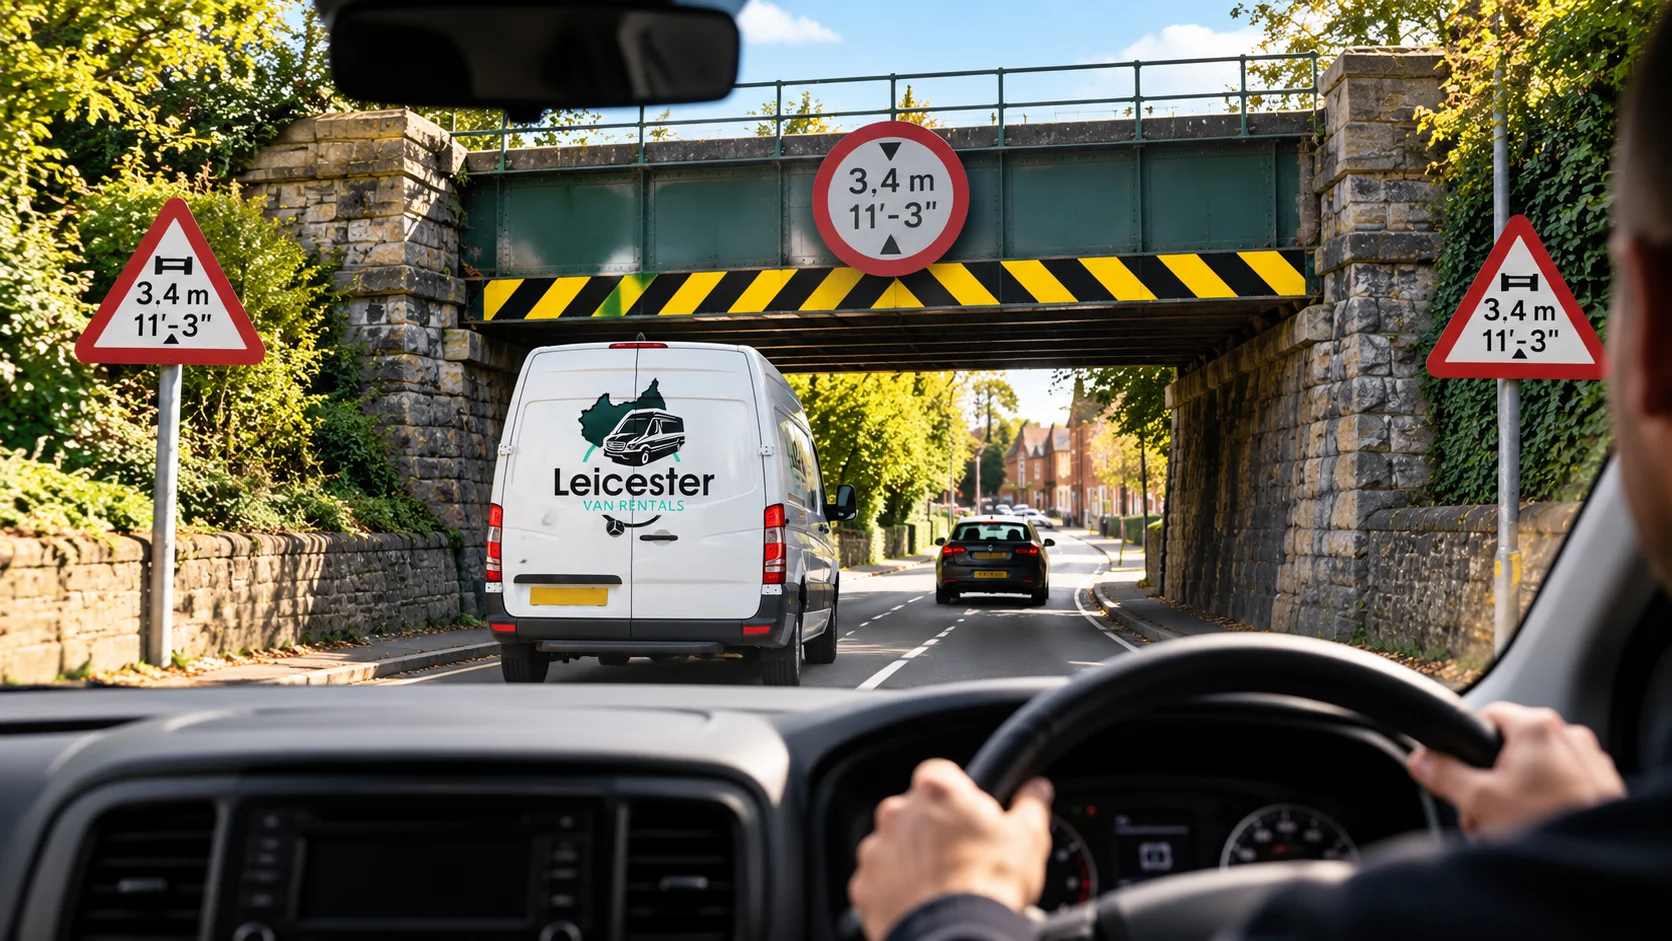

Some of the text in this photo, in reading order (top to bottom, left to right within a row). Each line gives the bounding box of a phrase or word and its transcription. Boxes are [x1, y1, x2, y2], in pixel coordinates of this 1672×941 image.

[909, 174, 935, 192] m
[187, 289, 209, 305] m
[1534, 305, 1556, 321] m
[554, 467, 715, 497] Leicester
[582, 499, 685, 512] VAN RENTALS
